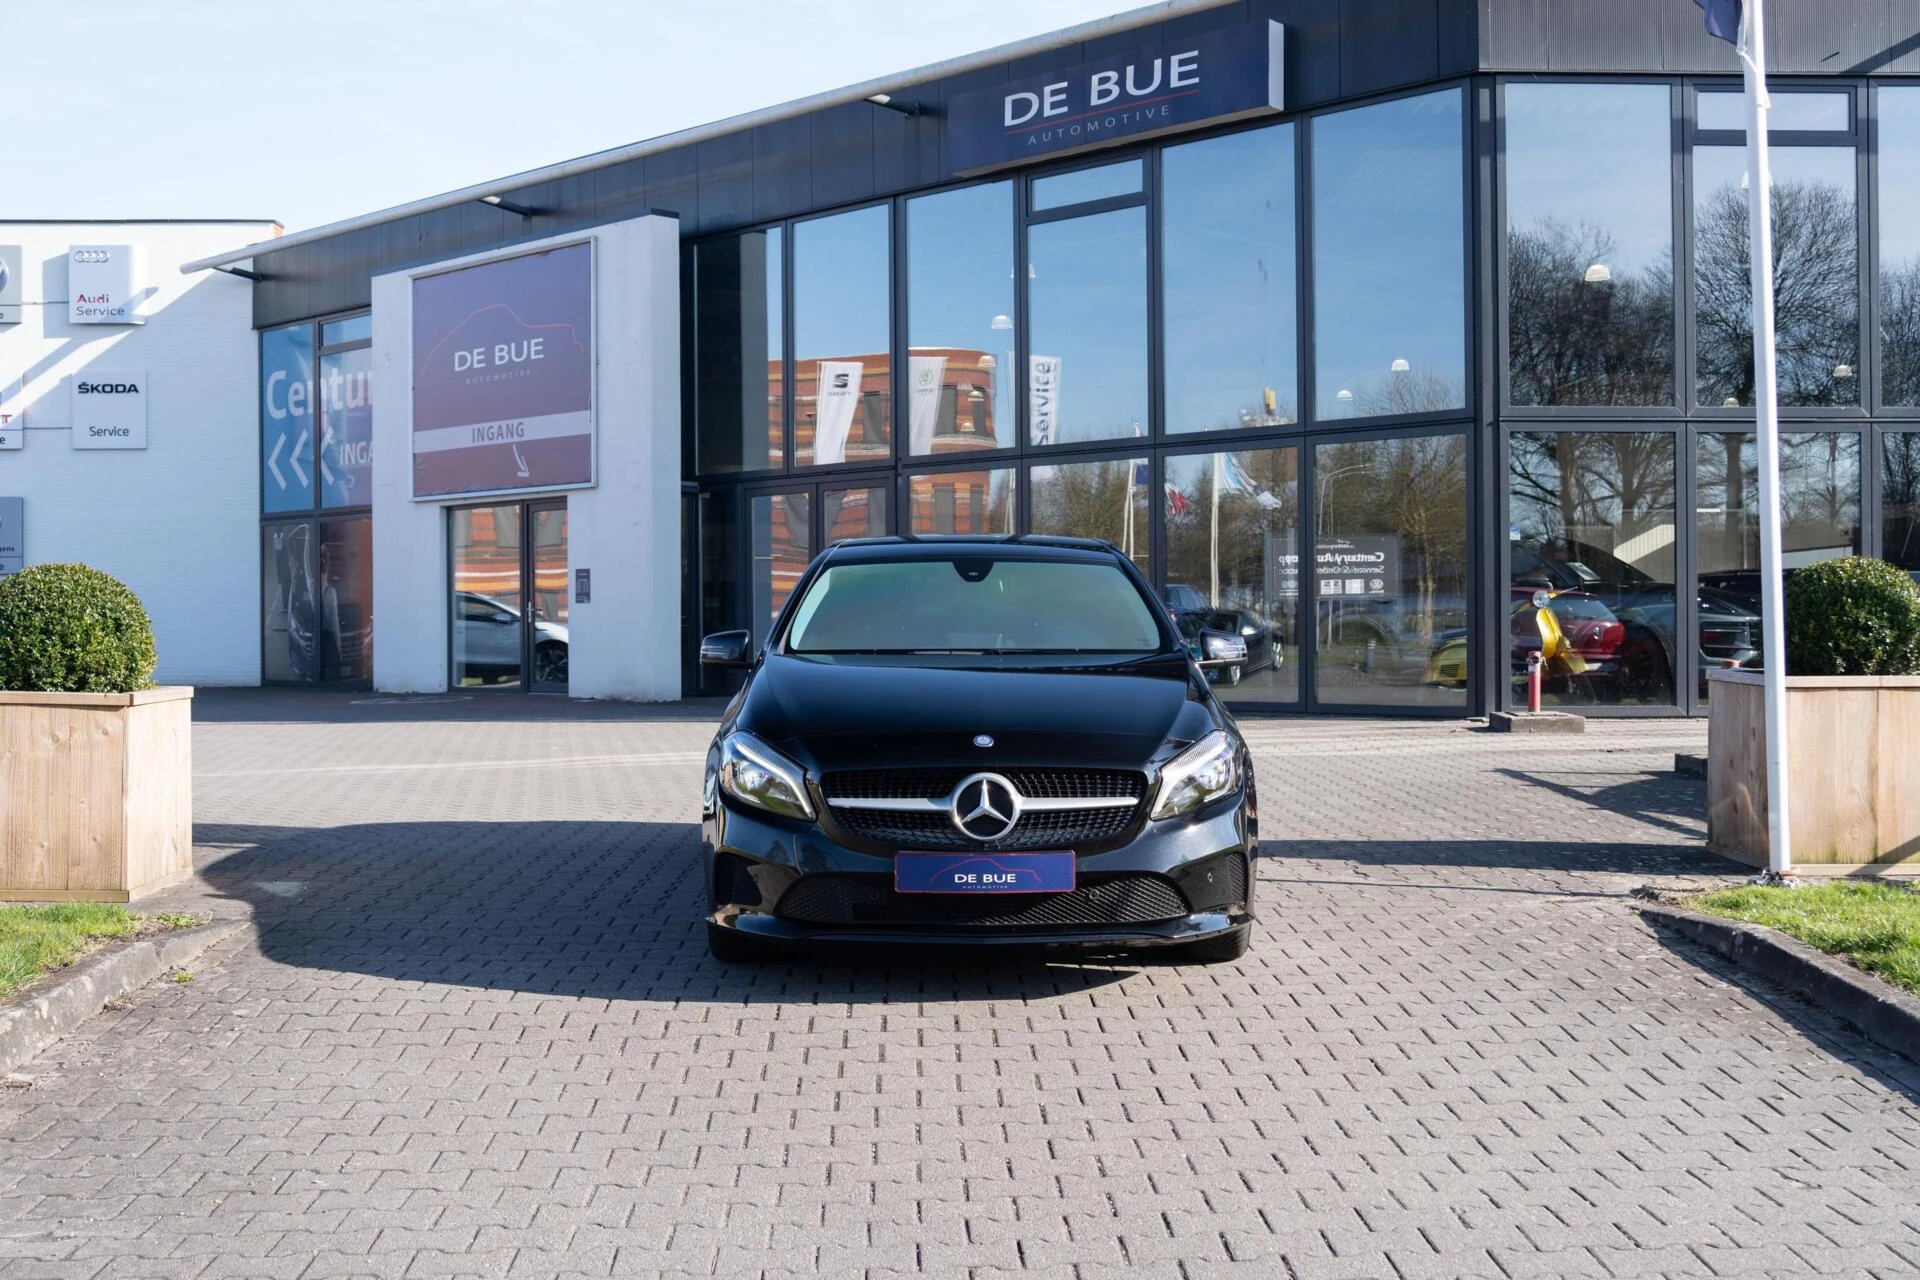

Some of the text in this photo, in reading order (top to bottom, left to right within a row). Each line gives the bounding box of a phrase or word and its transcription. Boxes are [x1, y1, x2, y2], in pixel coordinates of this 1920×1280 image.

[1004, 50, 1200, 127] DE BUE
[1028, 105, 1170, 145] AUTOMOTIVE
[77, 293, 109, 304] Audi
[76, 306, 125, 316] Service
[454, 338, 544, 372] DE BUE
[78, 381, 139, 394] ŠKODA
[88, 426, 130, 437] Service
[472, 421, 525, 443] INGANG
[954, 874, 1017, 883] DE BUE
